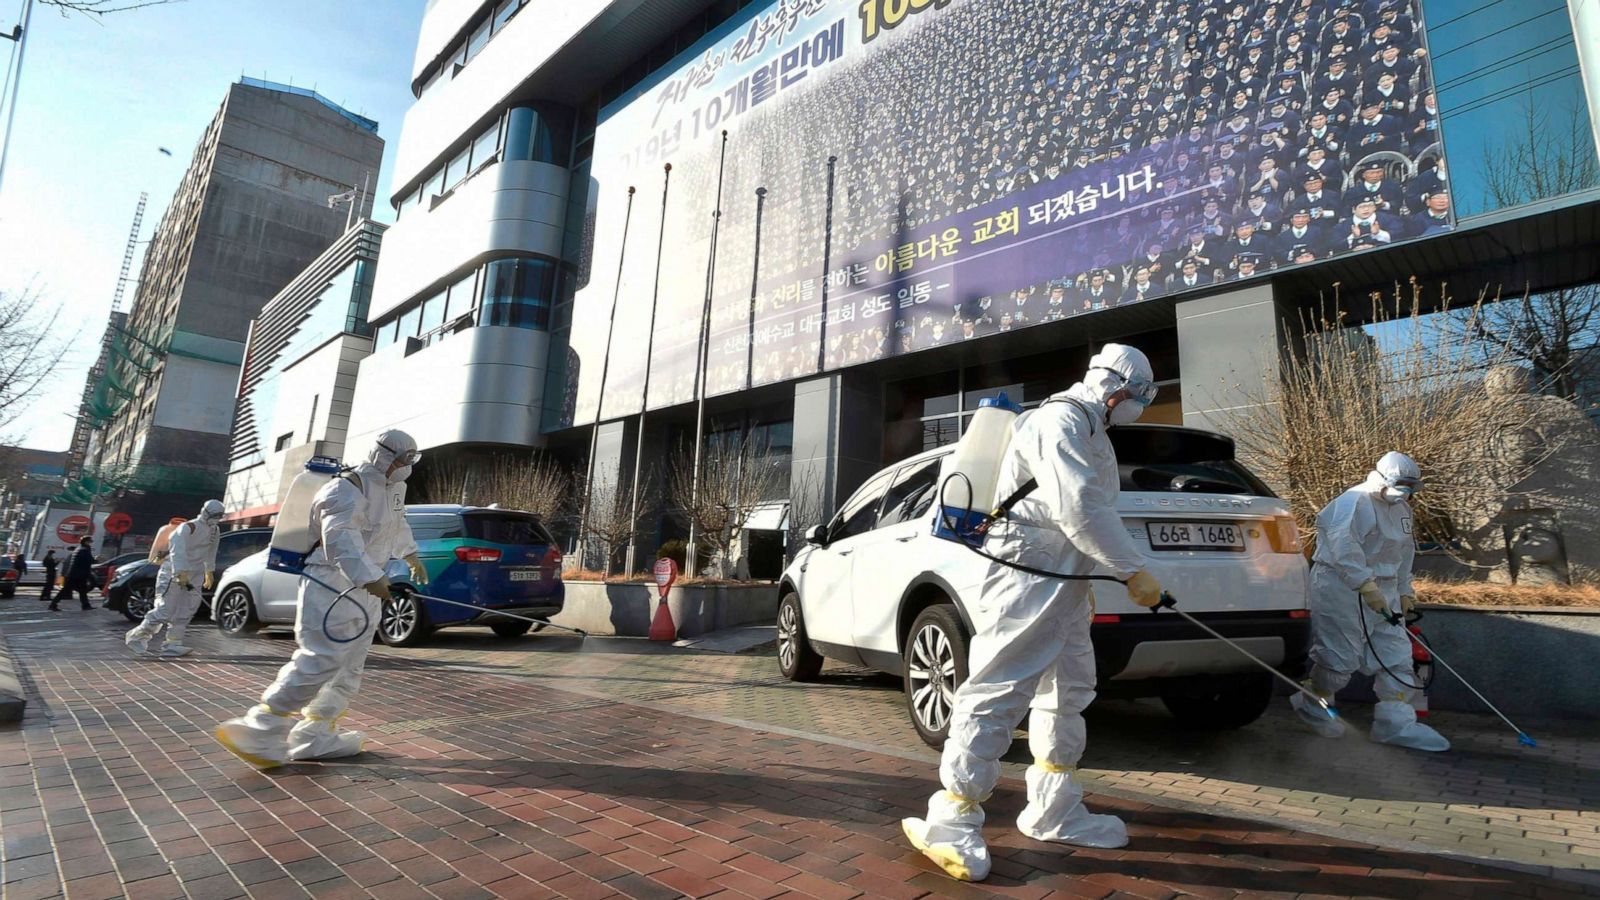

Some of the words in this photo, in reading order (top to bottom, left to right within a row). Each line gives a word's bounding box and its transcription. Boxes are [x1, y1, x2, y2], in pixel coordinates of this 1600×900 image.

[692, 17, 844, 140] 10개월만에
[773, 279, 816, 309] 진리를
[875, 226, 962, 275] 아름다운
[970, 206, 1020, 245] 교회
[1026, 165, 1163, 226] 되겠습니다.
[860, 294, 892, 318] 성도
[897, 280, 932, 309] 일동
[1134, 498, 1253, 508] DISCOVERY
[1197, 526, 1236, 544] 1648
